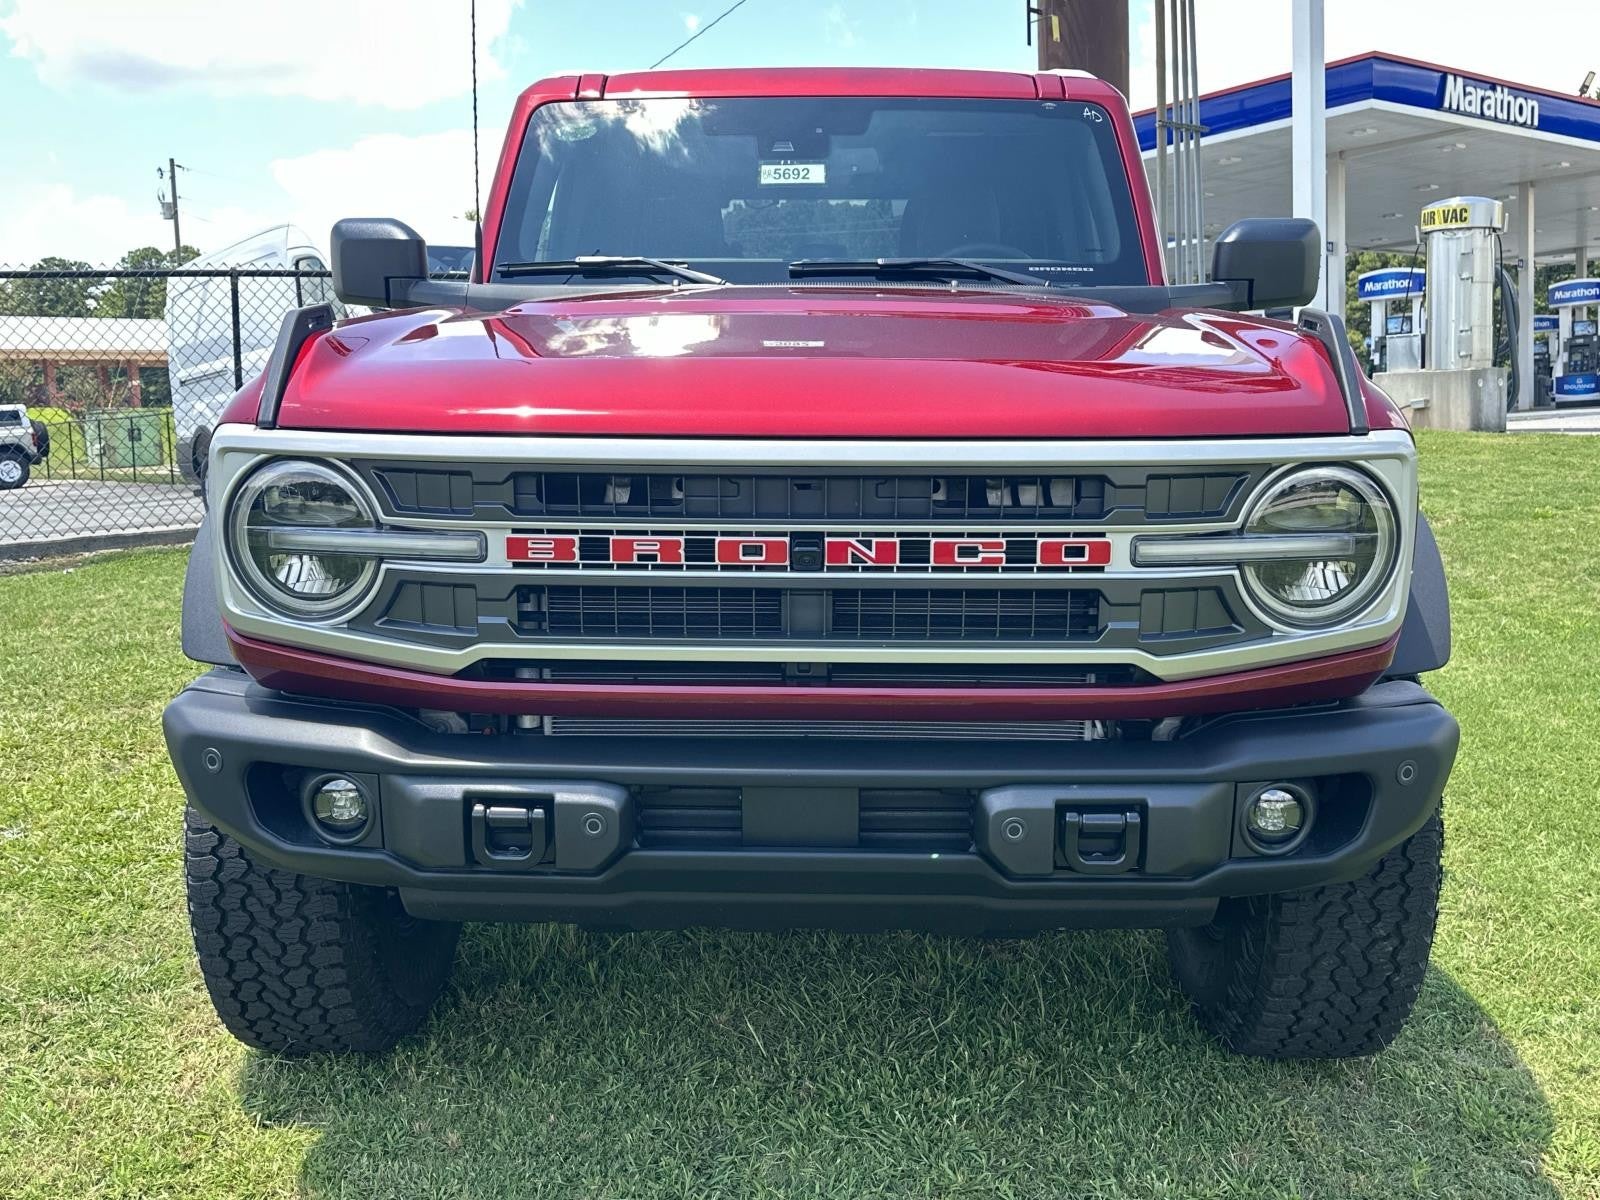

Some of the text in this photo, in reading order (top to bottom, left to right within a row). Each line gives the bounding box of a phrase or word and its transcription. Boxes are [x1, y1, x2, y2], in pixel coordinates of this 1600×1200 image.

[1443, 73, 1539, 128] Marathon
[773, 167, 810, 180] 5692
[1422, 207, 1468, 226] AIR VAC
[1364, 279, 1413, 292] Marathon
[1554, 287, 1599, 300] Marathon
[505, 535, 1112, 566] BRONCO
